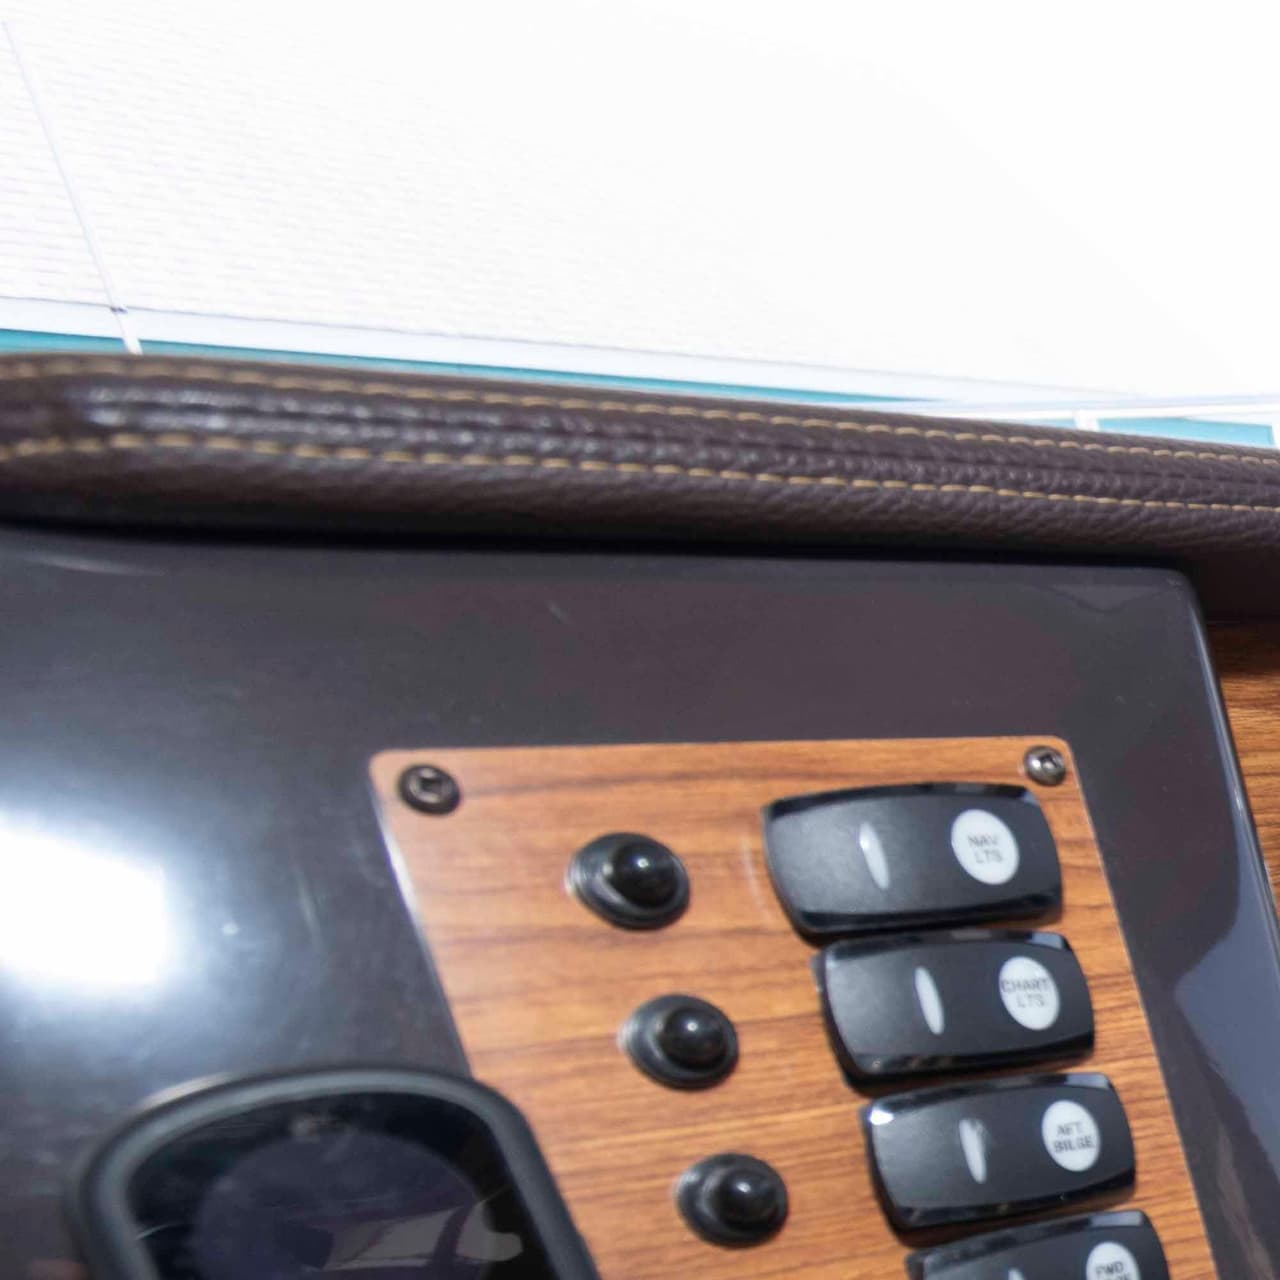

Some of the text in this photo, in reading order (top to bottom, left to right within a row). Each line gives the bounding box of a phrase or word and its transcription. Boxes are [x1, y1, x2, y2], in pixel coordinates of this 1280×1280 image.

[967, 834, 999, 847] NAV
[974, 850, 1003, 863] LTS
[1001, 978, 1049, 994] CHART
[1016, 994, 1044, 1008] LTS
[1057, 1122, 1082, 1136] AFT
[1053, 1135, 1095, 1154] BILGE
[1095, 1260, 1125, 1277] FWD
